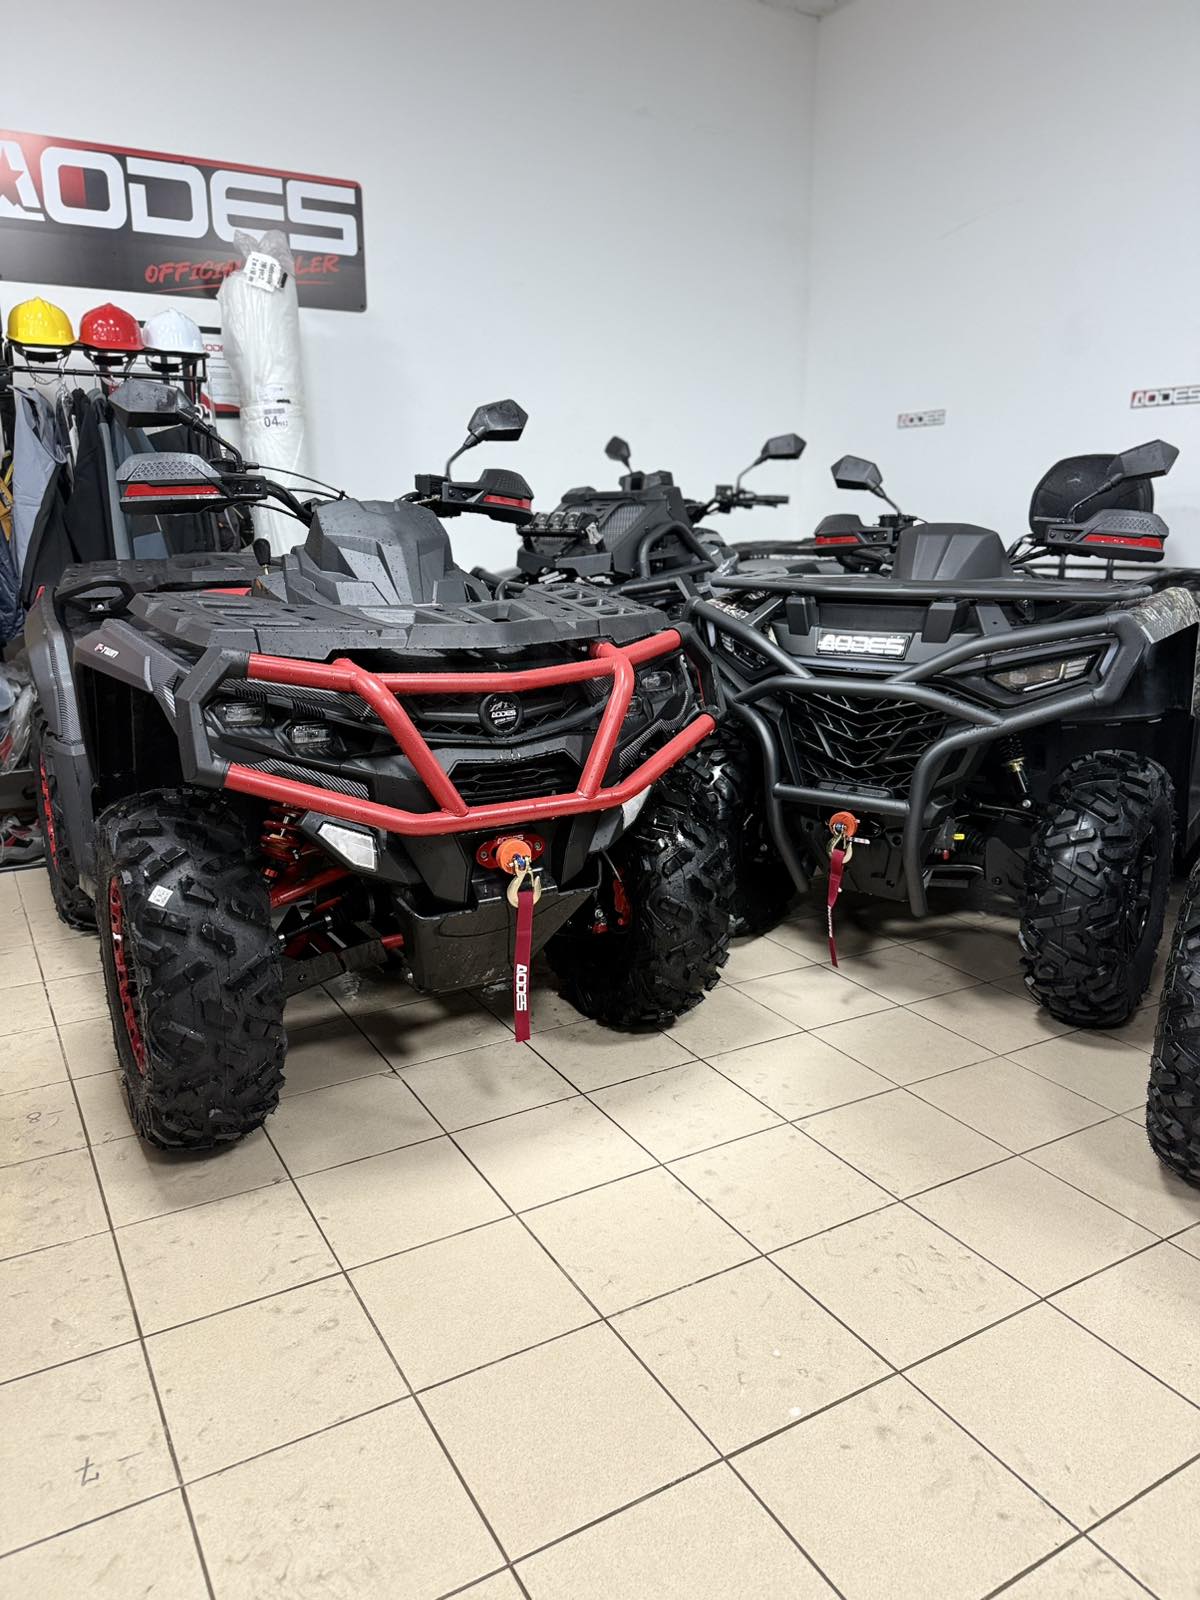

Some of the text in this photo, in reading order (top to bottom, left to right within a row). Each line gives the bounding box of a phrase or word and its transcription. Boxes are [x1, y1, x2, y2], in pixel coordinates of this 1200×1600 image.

[295, 254, 341, 274] LER
[817, 634, 905, 655] AODES
[516, 963, 528, 1011] AODES
